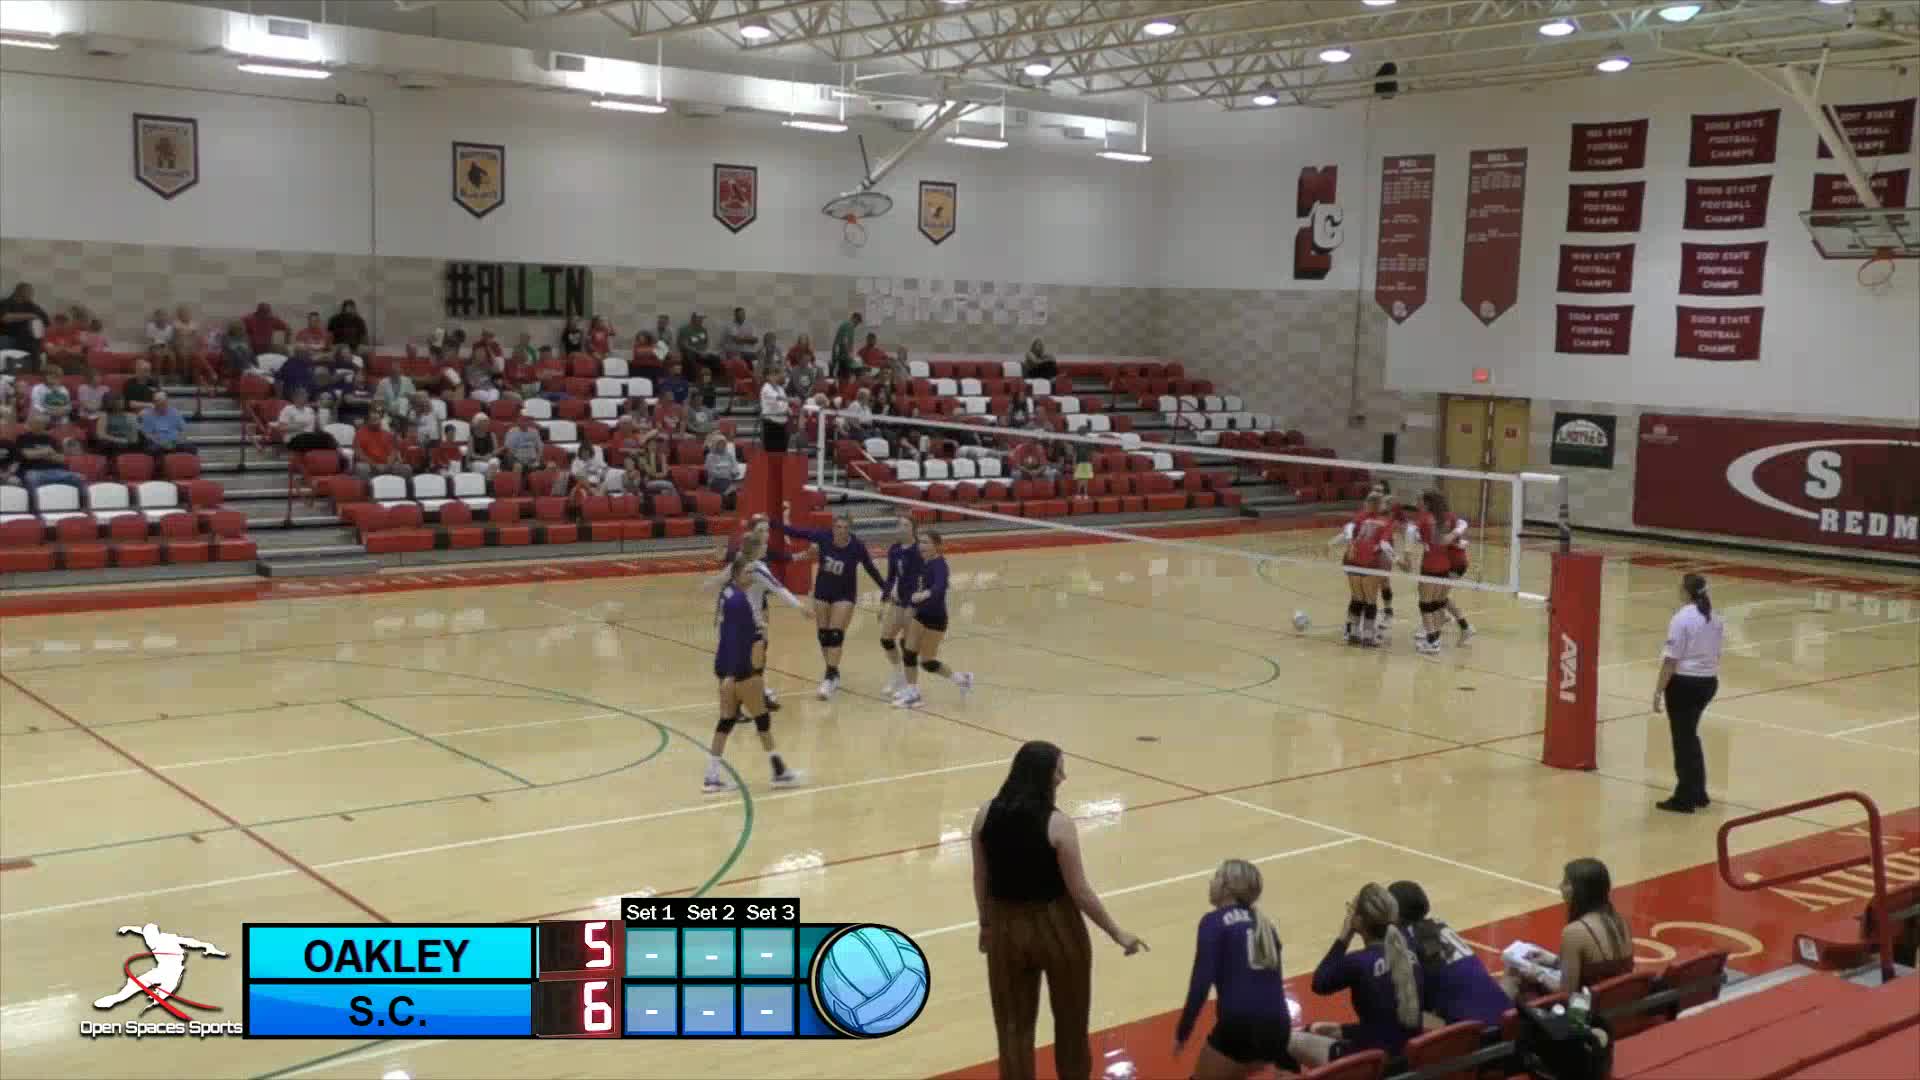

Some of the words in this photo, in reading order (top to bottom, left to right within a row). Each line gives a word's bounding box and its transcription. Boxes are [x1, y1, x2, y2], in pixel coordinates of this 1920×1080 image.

[1722, 251, 1752, 261] STATE
[1697, 265, 1745, 275] FOOTBALL
[1702, 280, 1739, 289] CHAMPS
